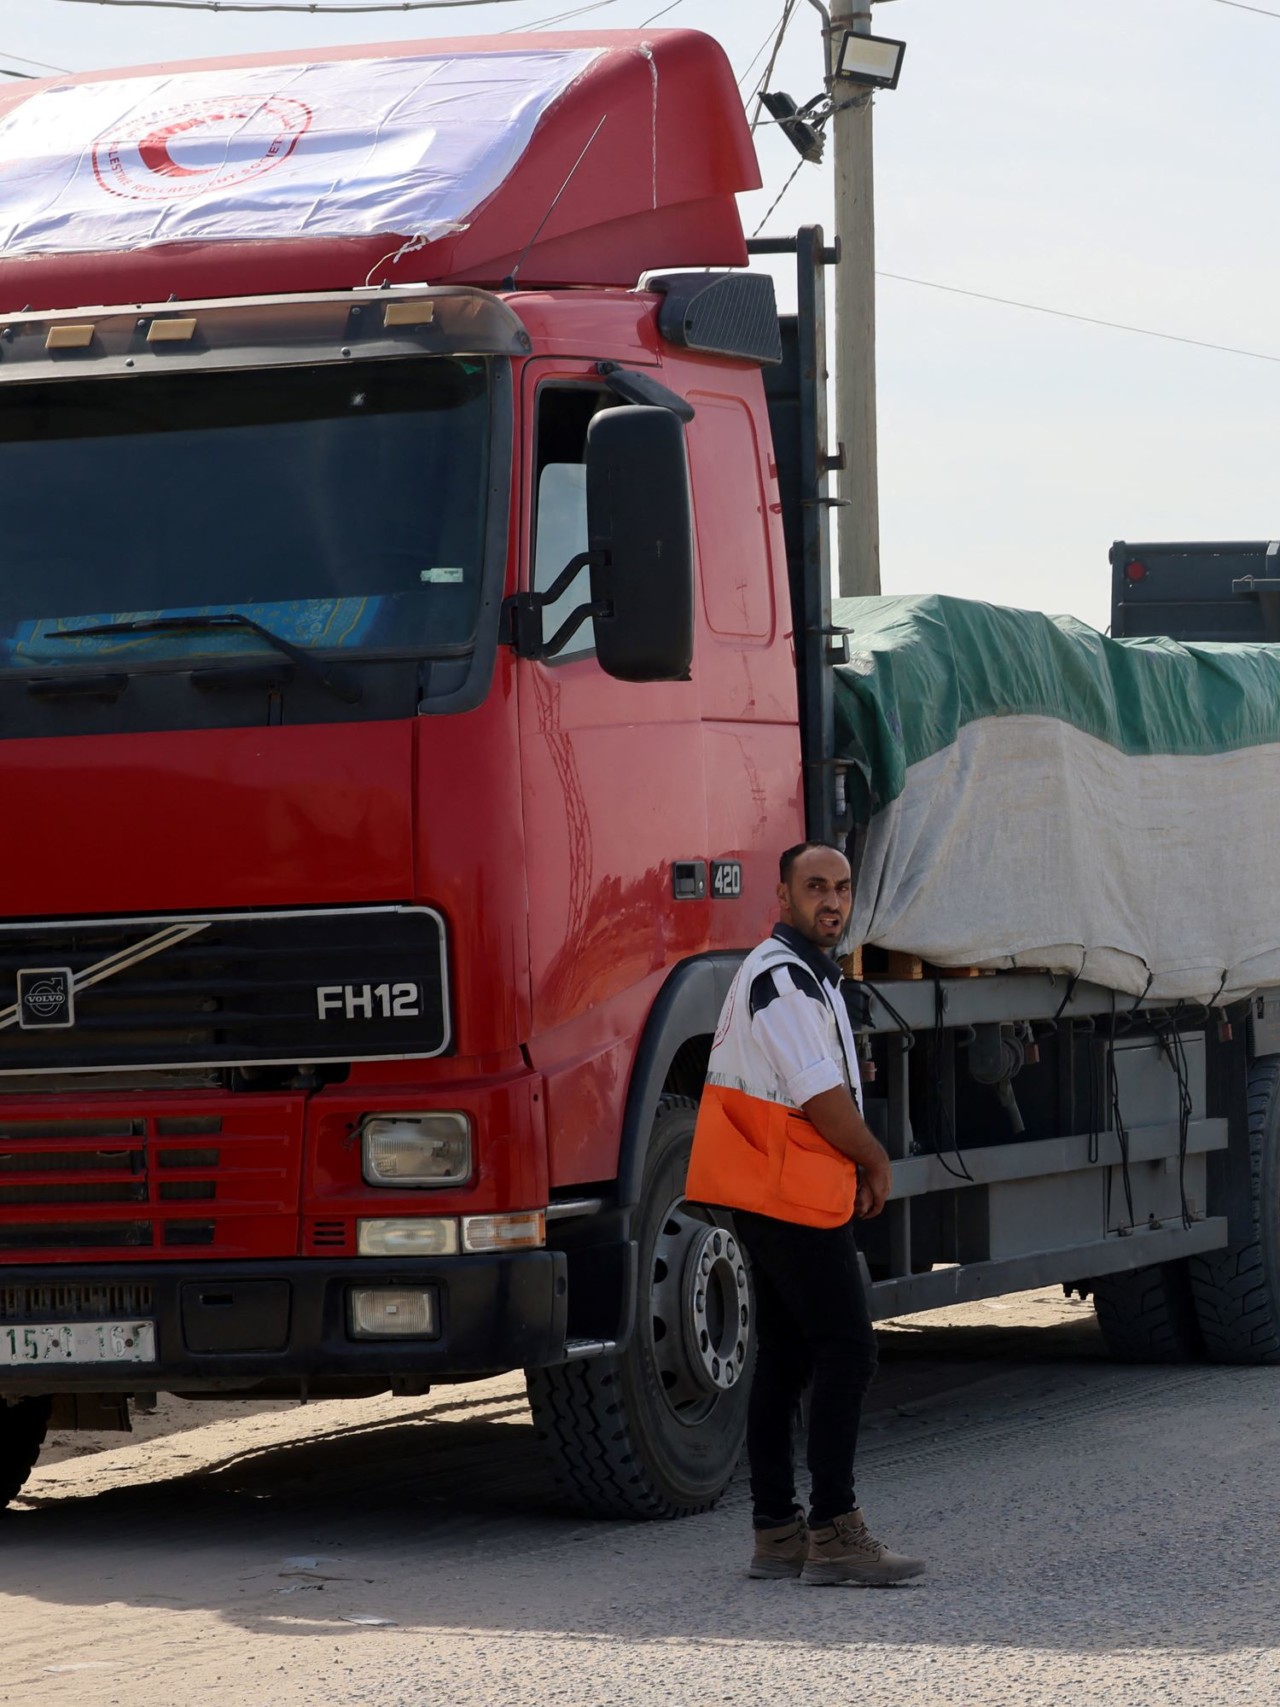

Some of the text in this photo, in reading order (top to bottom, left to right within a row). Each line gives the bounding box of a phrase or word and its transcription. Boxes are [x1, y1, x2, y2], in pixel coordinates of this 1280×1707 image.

[714, 865, 740, 894] 420
[27, 995, 63, 1003] VOLVO
[316, 982, 419, 1020] FH12
